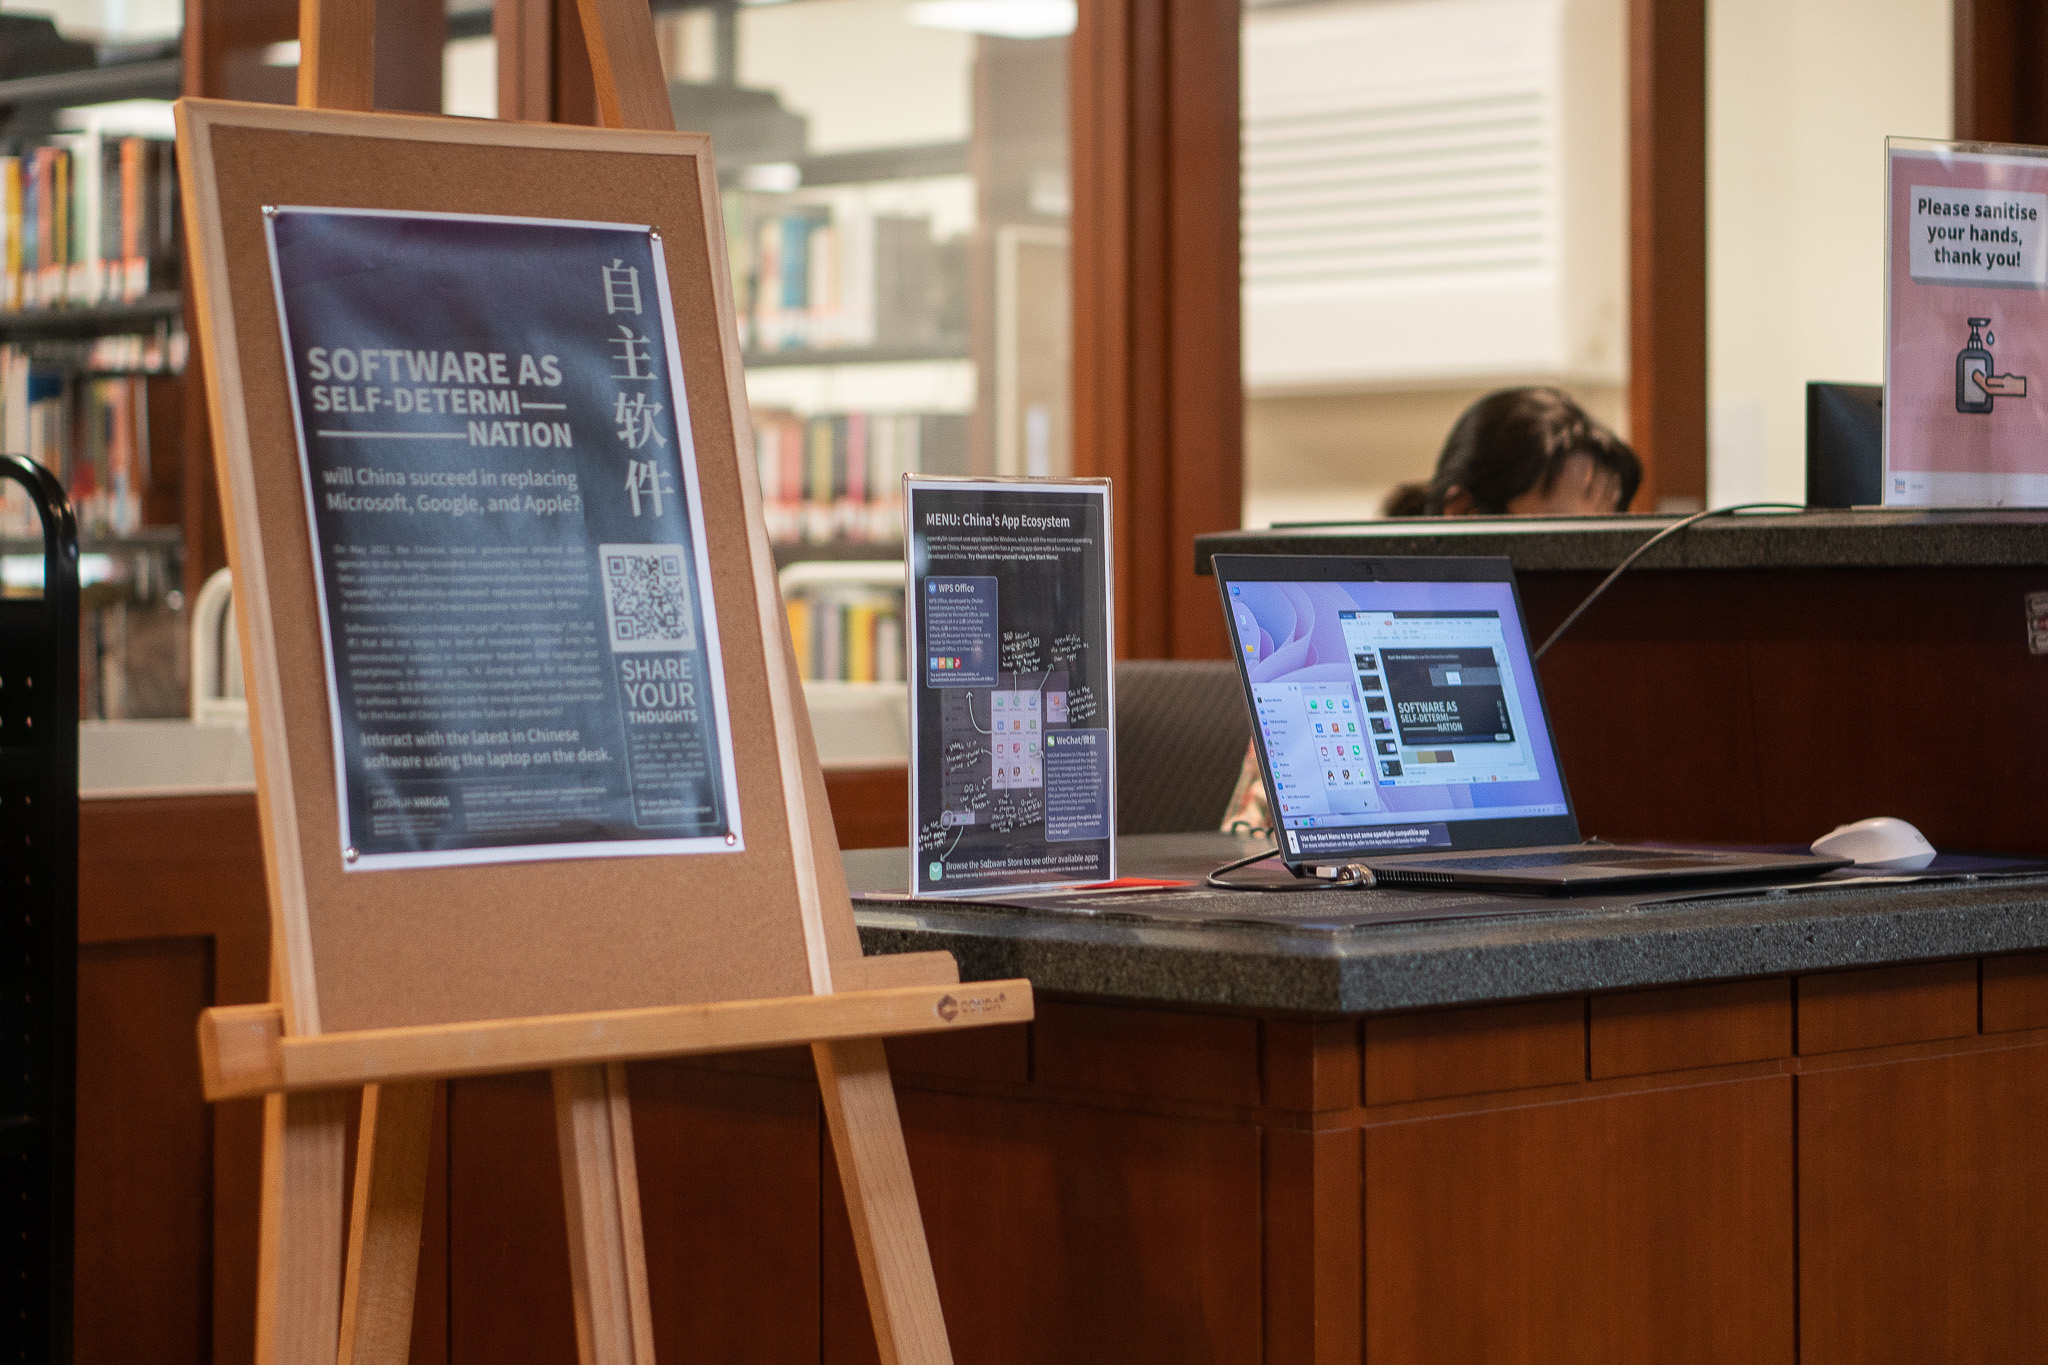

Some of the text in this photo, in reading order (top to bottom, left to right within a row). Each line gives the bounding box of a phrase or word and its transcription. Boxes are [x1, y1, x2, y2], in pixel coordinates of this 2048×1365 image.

[1917, 197, 2037, 221] Please sanitise
[1927, 222, 2023, 247] your hands,
[1934, 247, 2021, 270] thank you!
[307, 346, 563, 388] SOFTWARE AS
[601, 258, 675, 517] 自主软件
[323, 467, 578, 492] will China succeed in replacing
[325, 491, 580, 517] Microsoft, Google, and Apple?
[926, 513, 1070, 531] MENU: China's App Ecosystem
[938, 583, 975, 593] WPS Office
[621, 658, 693, 681] SHARE
[624, 682, 695, 708] YOUR
[628, 709, 698, 724] THOUGHTS
[1397, 701, 1458, 713] SOFTWARE AS
[360, 727, 580, 748] Interact with the latest in Chinese
[363, 747, 613, 771] software using the laptop on the desk.
[1373, 829, 1418, 838] openKylin-compatible
[946, 854, 1098, 870] Browse the Software Store to see other available apps
